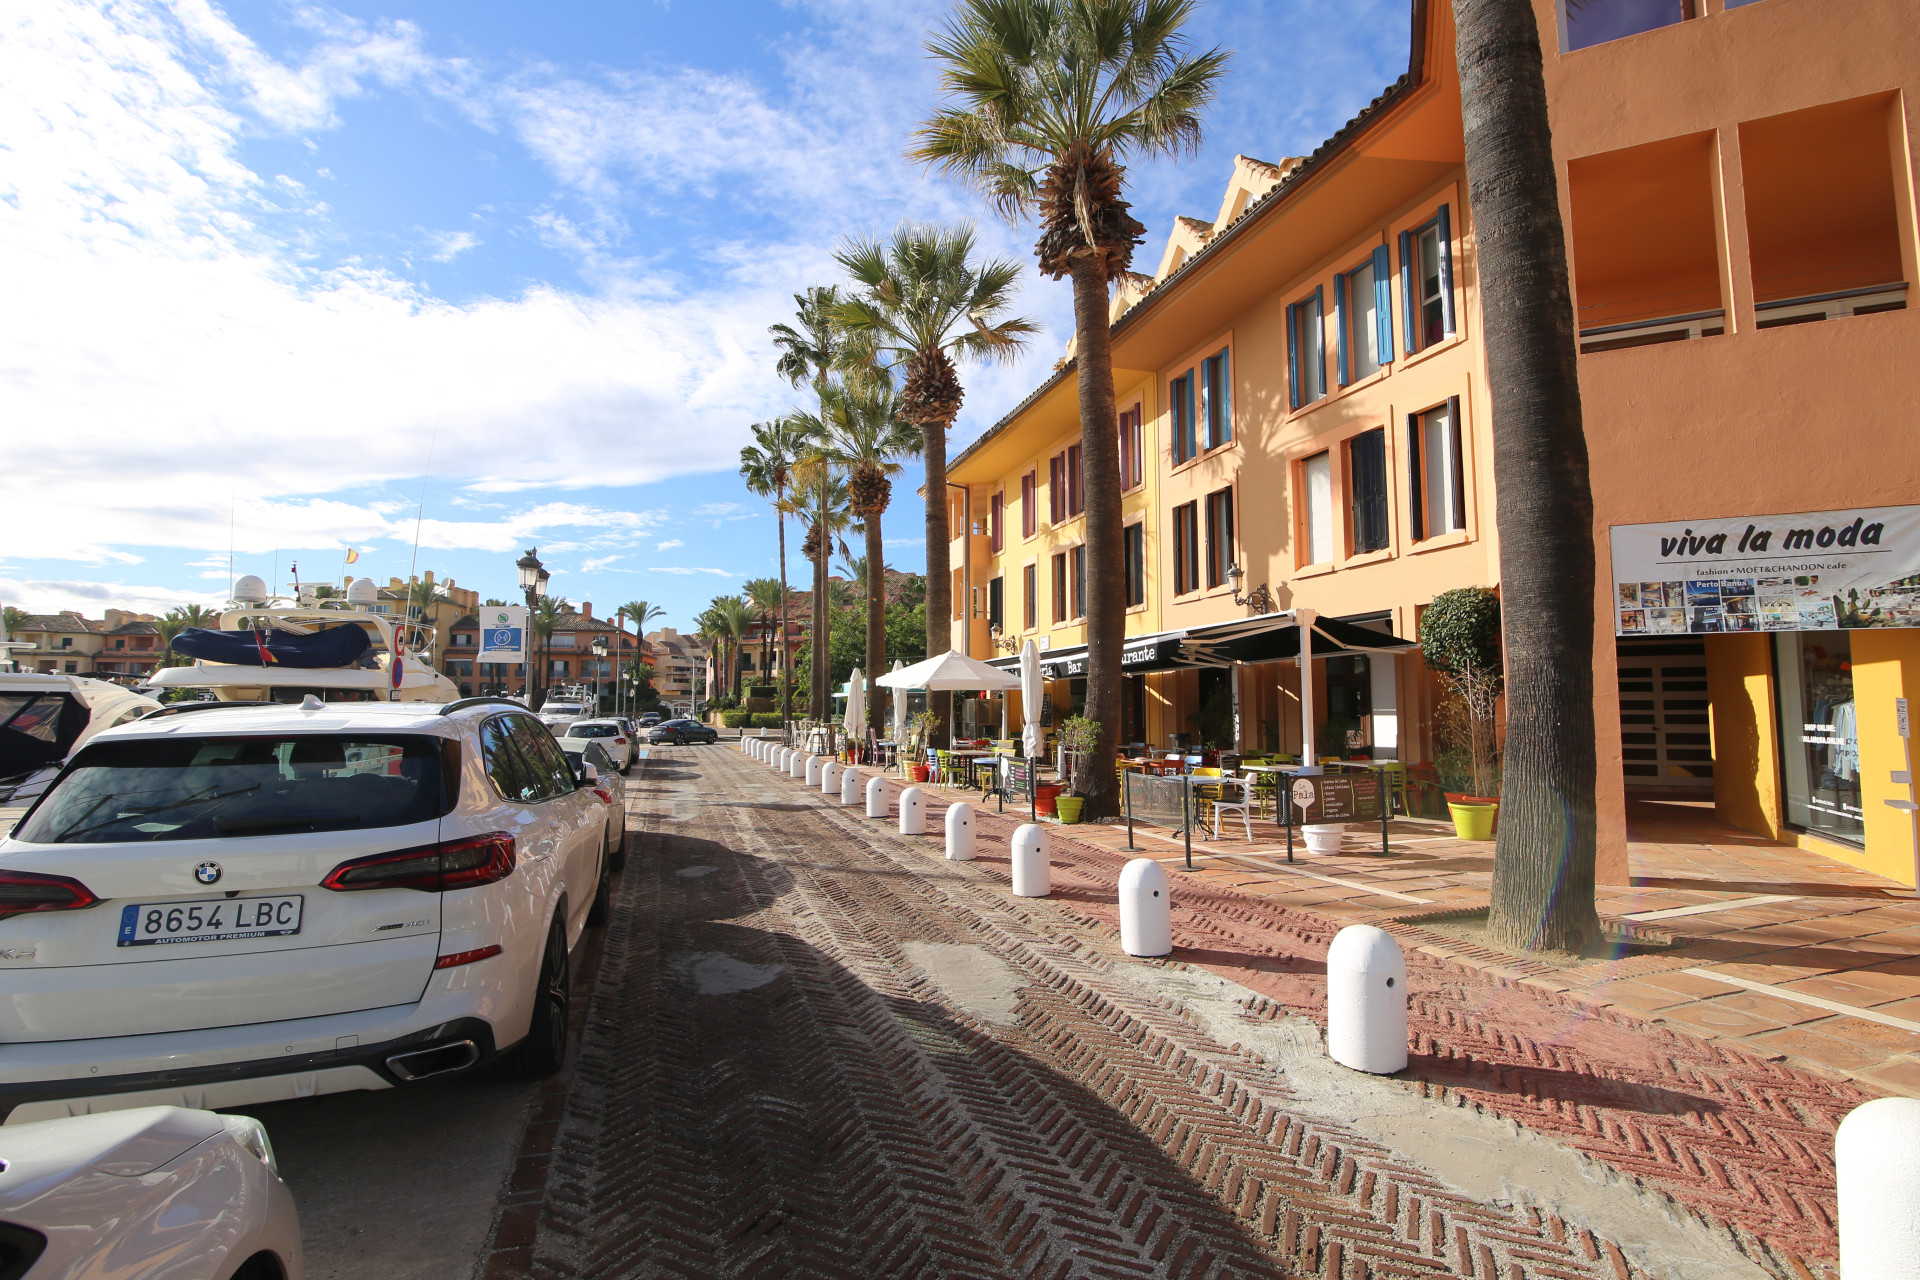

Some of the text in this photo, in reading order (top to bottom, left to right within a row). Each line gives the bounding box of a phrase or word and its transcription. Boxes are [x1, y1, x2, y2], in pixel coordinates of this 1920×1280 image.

[1660, 517, 1885, 557] viva la moda
[1696, 568, 1729, 576] fashion
[1826, 562, 1847, 570] cafe
[1121, 645, 1155, 664] urante
[1067, 660, 1082, 675] Bar
[1293, 790, 1314, 800] Pala
[144, 901, 294, 934] 8654 LBC
[124, 926, 131, 935] E
[155, 931, 265, 945] AUTOMOTOR PREMIUM
